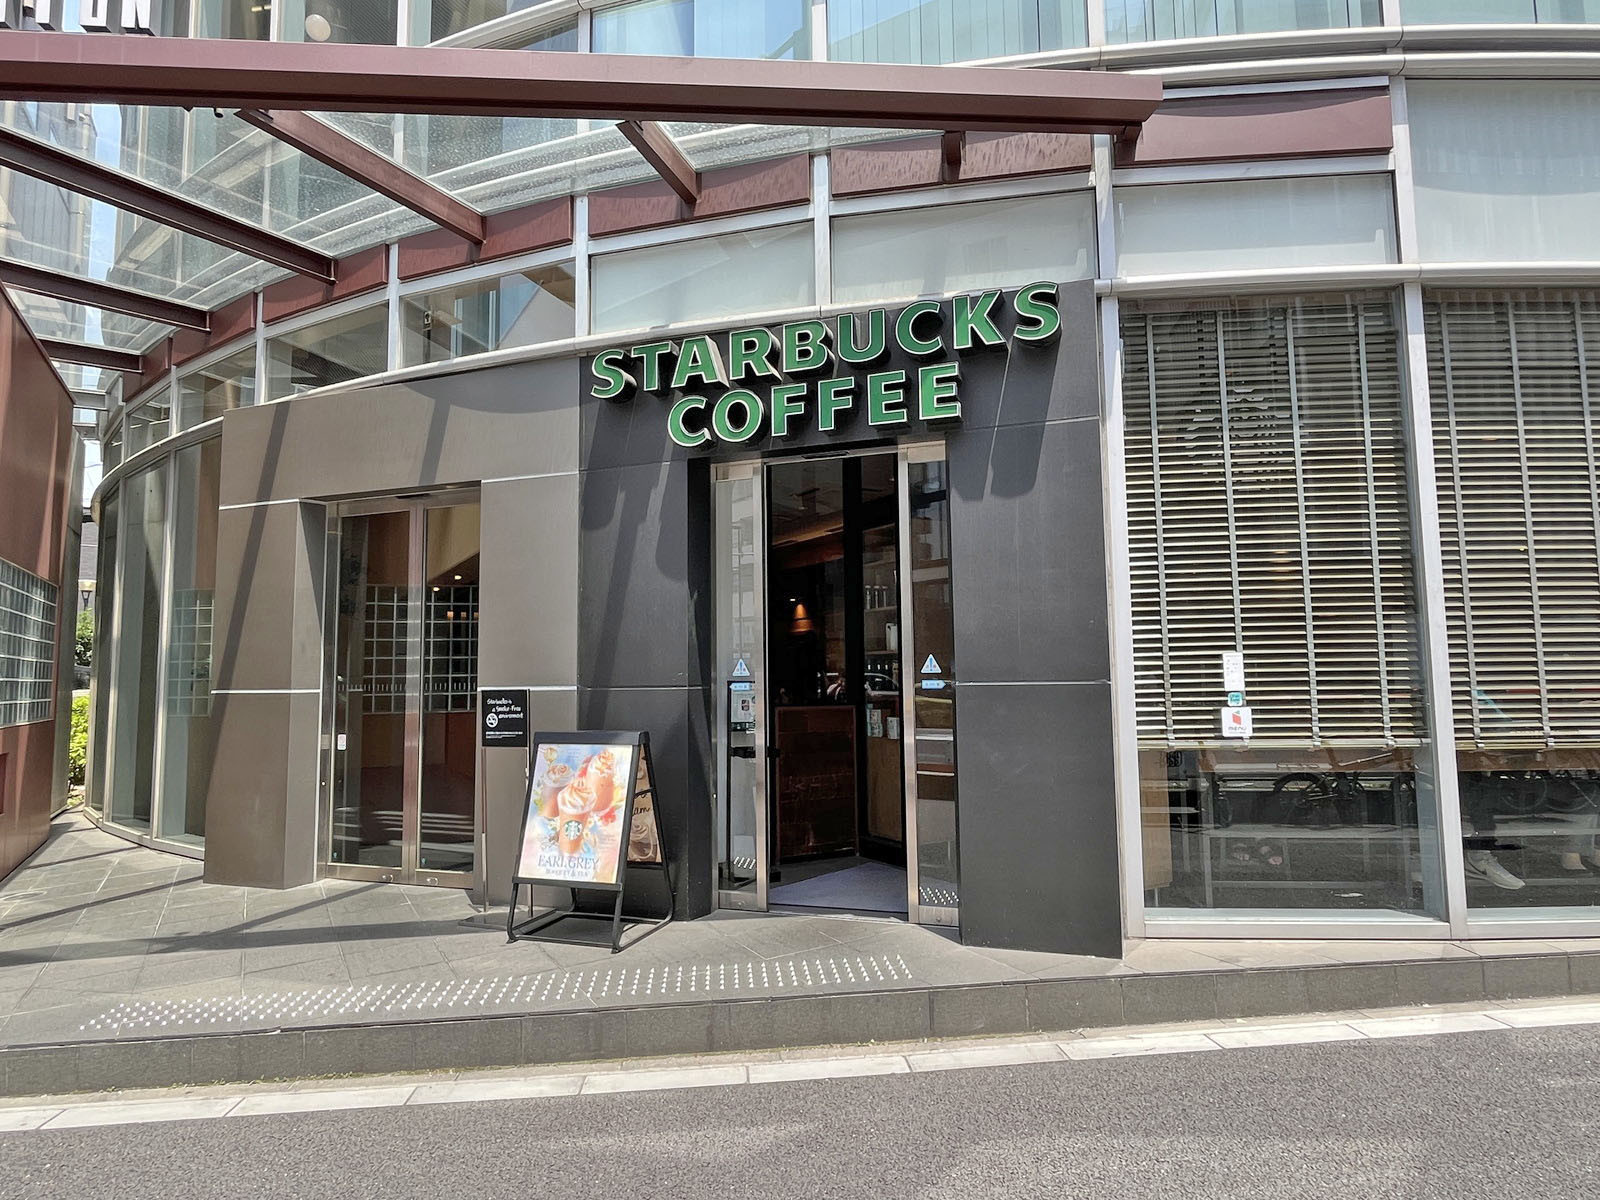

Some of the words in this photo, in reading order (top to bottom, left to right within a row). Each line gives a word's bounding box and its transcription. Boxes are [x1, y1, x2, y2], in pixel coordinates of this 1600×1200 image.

[590, 281, 1061, 399] STARBUCKS
[667, 362, 963, 447] COFFEE
[538, 855, 567, 868] EARL
[568, 856, 599, 870] GREY
